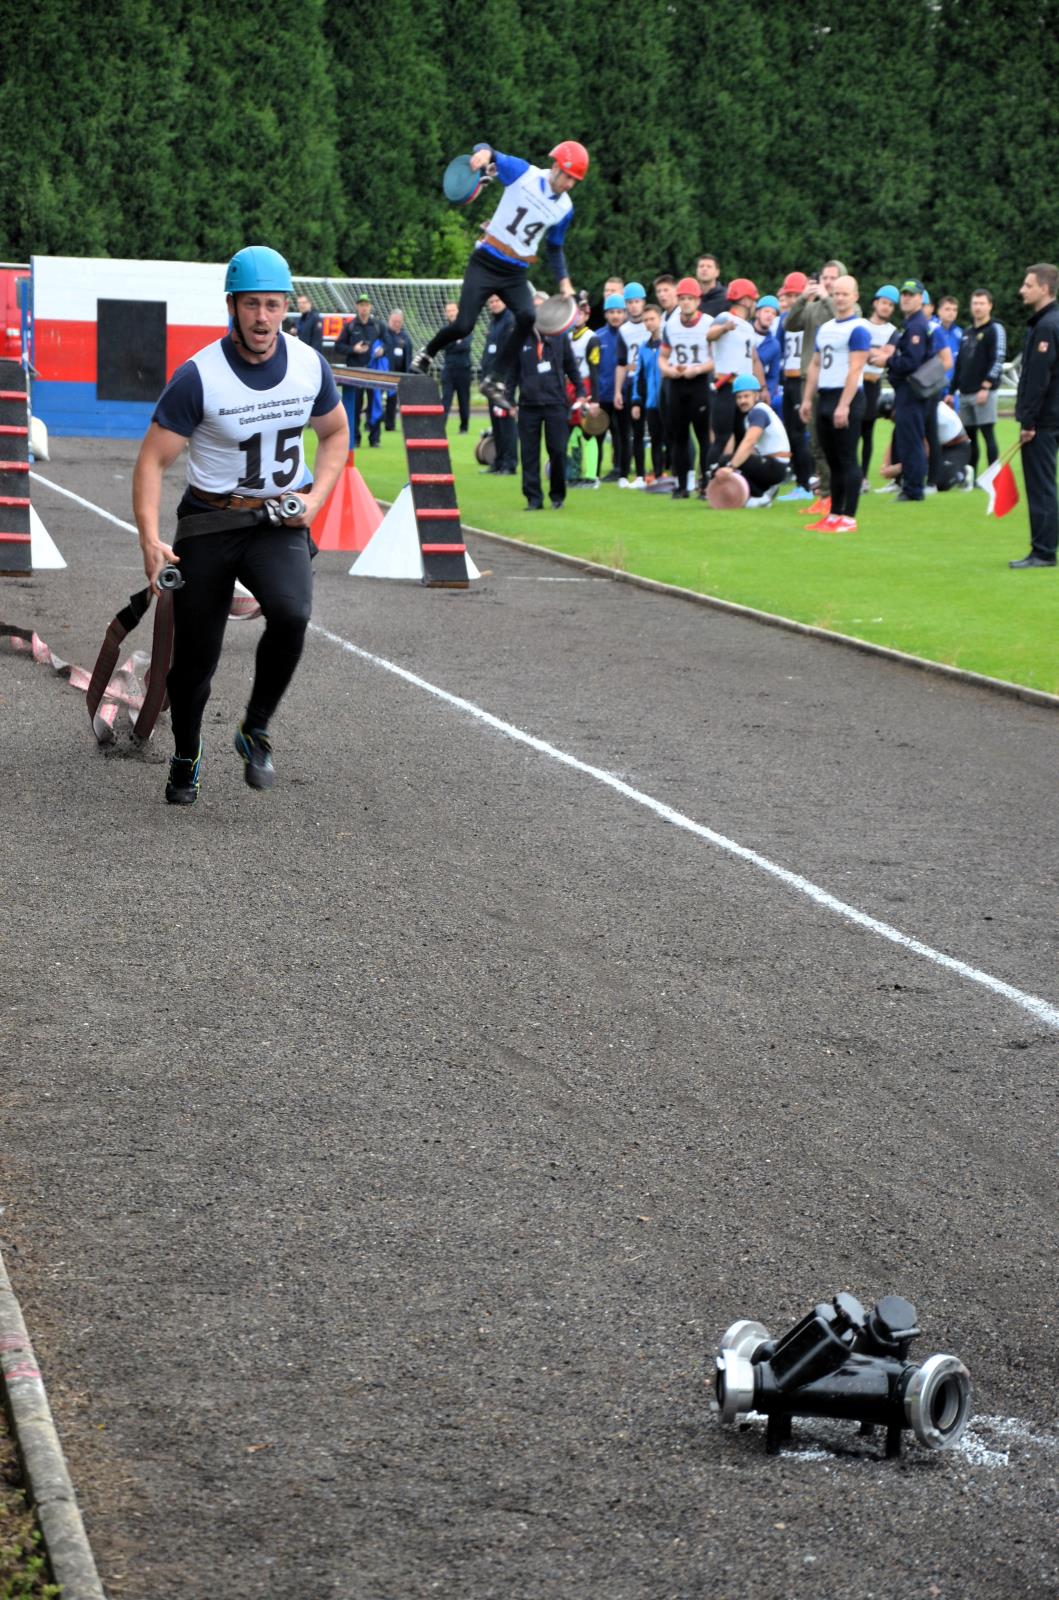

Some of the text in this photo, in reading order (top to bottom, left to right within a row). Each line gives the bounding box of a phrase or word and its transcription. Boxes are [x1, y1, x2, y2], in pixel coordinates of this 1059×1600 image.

[506, 206, 545, 247] 14
[674, 343, 702, 364] 61
[237, 426, 303, 489] 15
